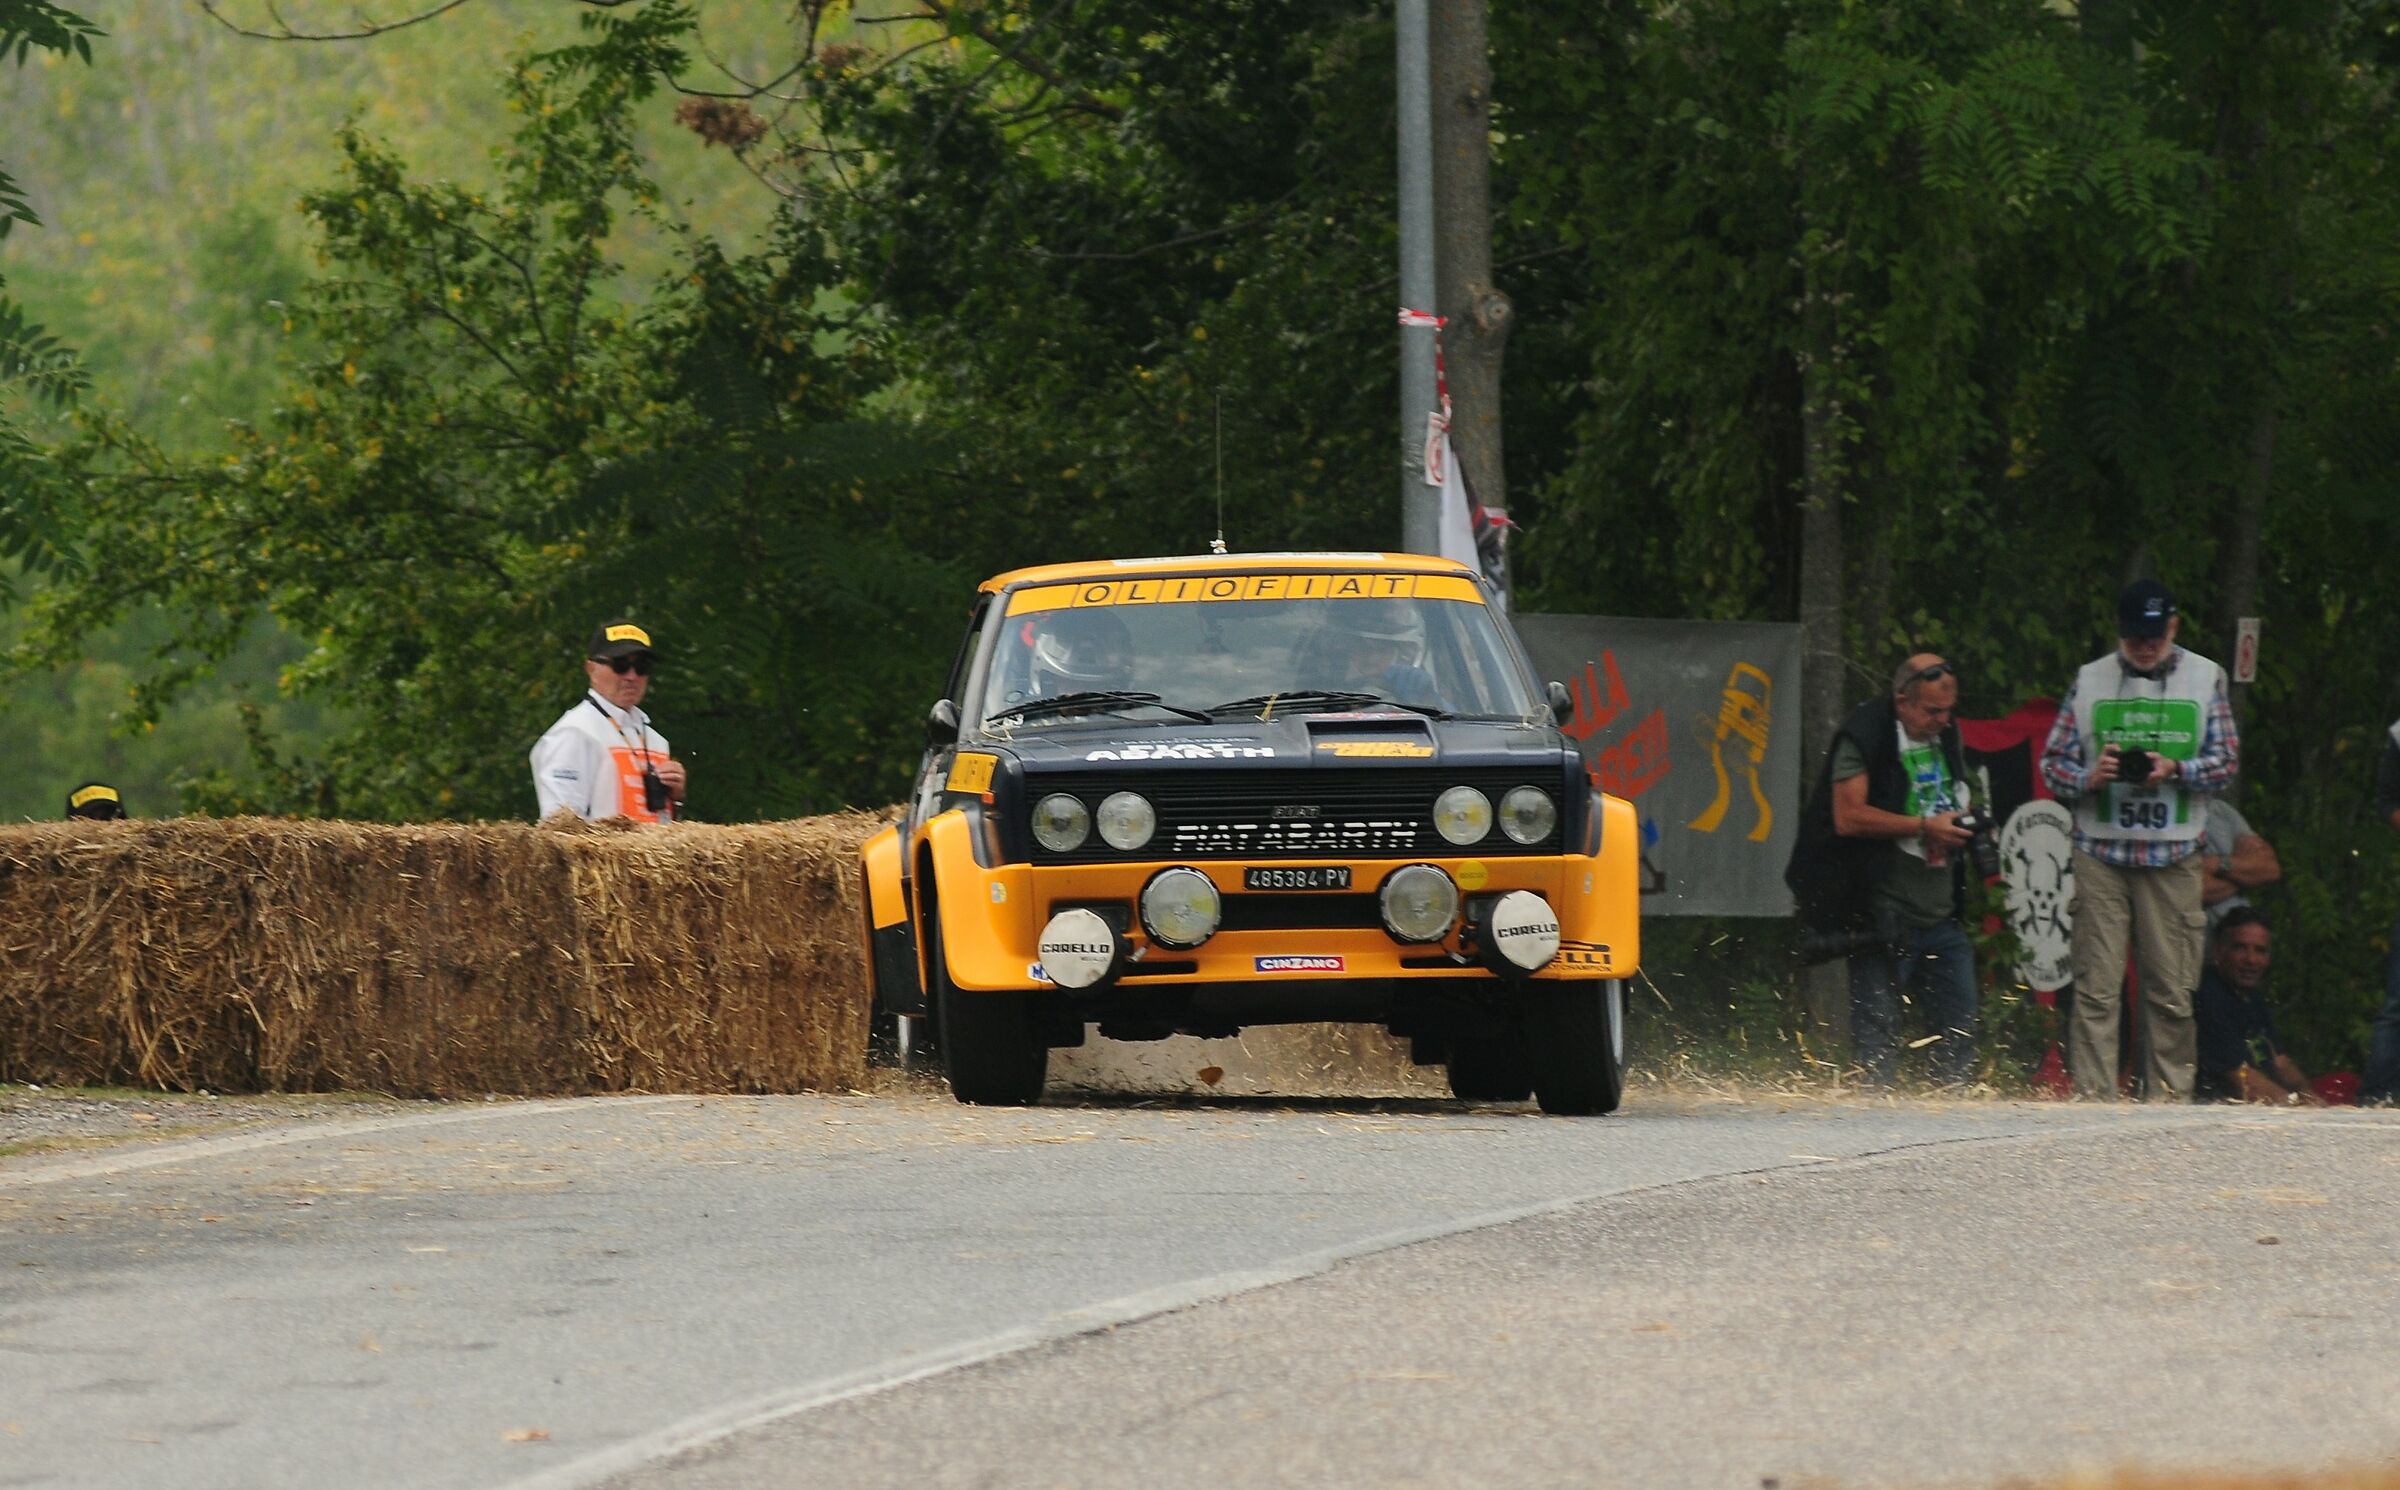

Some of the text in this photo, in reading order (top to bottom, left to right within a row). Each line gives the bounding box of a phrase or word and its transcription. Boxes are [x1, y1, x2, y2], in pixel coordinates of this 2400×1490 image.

[1558, 648, 1631, 743] LLA
[1085, 747, 1275, 762] ABARTH
[1275, 806, 1320, 817] FIAT
[2120, 802, 2169, 829] 549
[1173, 821, 1418, 851] FIAT ABARTH
[1249, 868, 1349, 888] 485384 PV
[1497, 923, 1559, 938] CARELLO
[1042, 943, 1110, 954] CARELLO
[1260, 957, 1341, 970] CINZANO
